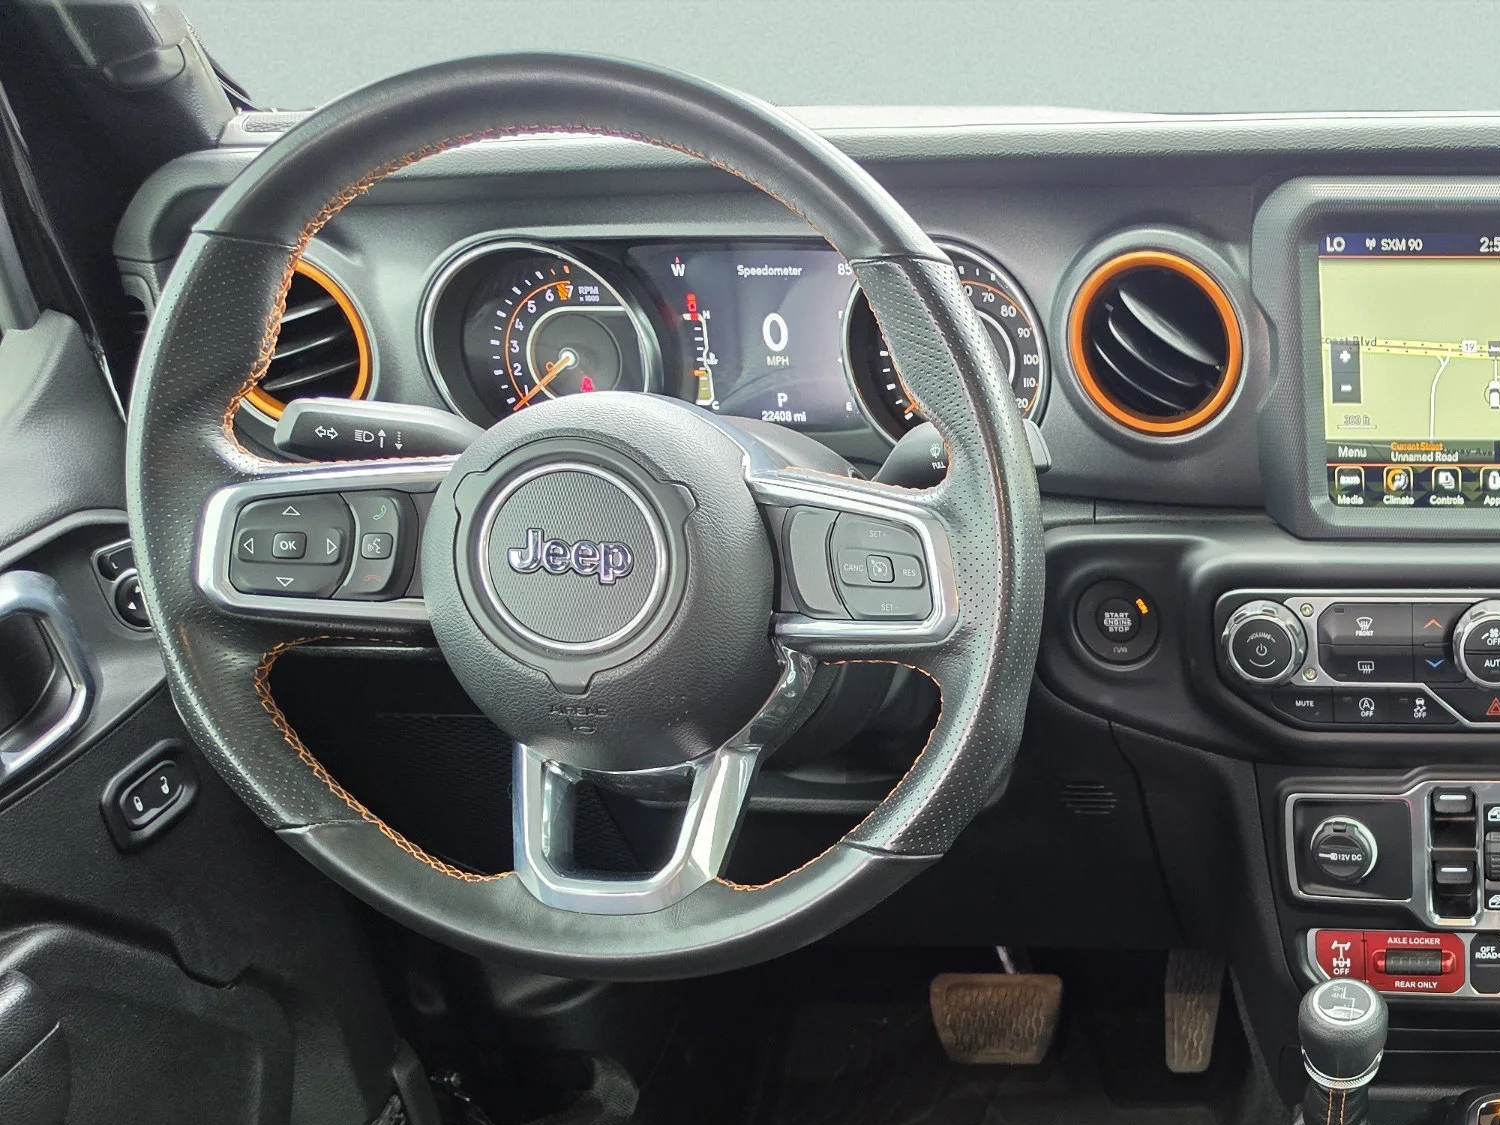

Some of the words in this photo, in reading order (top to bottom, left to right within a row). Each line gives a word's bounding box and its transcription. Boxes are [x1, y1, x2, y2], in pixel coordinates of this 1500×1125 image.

[1326, 236, 1346, 252] LO
[1381, 238, 1406, 251] SXM
[1408, 238, 1423, 251] 90
[671, 264, 685, 276] W
[737, 265, 802, 277] Speedometer
[545, 289, 554, 301] 6
[566, 285, 573, 298] 7
[578, 286, 599, 295] RPM
[982, 292, 995, 302] 70
[527, 300, 536, 313] 5
[1000, 305, 1016, 317] 80
[515, 318, 524, 331] 4
[762, 312, 788, 352] 0
[1017, 328, 1030, 337] 90
[510, 340, 520, 353] 3
[1465, 343, 1475, 351] 19
[766, 356, 789, 366] MPH
[1023, 354, 1039, 365] 100
[513, 363, 522, 376] 2
[1023, 377, 1035, 387] 110
[777, 393, 788, 407] P
[1016, 398, 1028, 409] 20
[762, 411, 790, 422] 22408
[794, 411, 806, 422] mi
[1338, 446, 1367, 457] Menu
[1390, 442, 1420, 451] Current
[1420, 442, 1443, 451] Street
[1391, 452, 1434, 462] Unnamed
[1435, 452, 1458, 462] Road
[932, 462, 947, 470] PULL
[1337, 495, 1364, 505] Media
[1383, 495, 1415, 505] Climate
[1430, 495, 1464, 505] Controls
[279, 540, 297, 550] OK
[507, 528, 634, 586] Jeep
[843, 563, 864, 572] CANC
[902, 569, 916, 577] RES
[1249, 632, 1272, 641] VOLUME
[1409, 937, 1440, 945] LOCKER
[1417, 981, 1438, 989] ONLY
